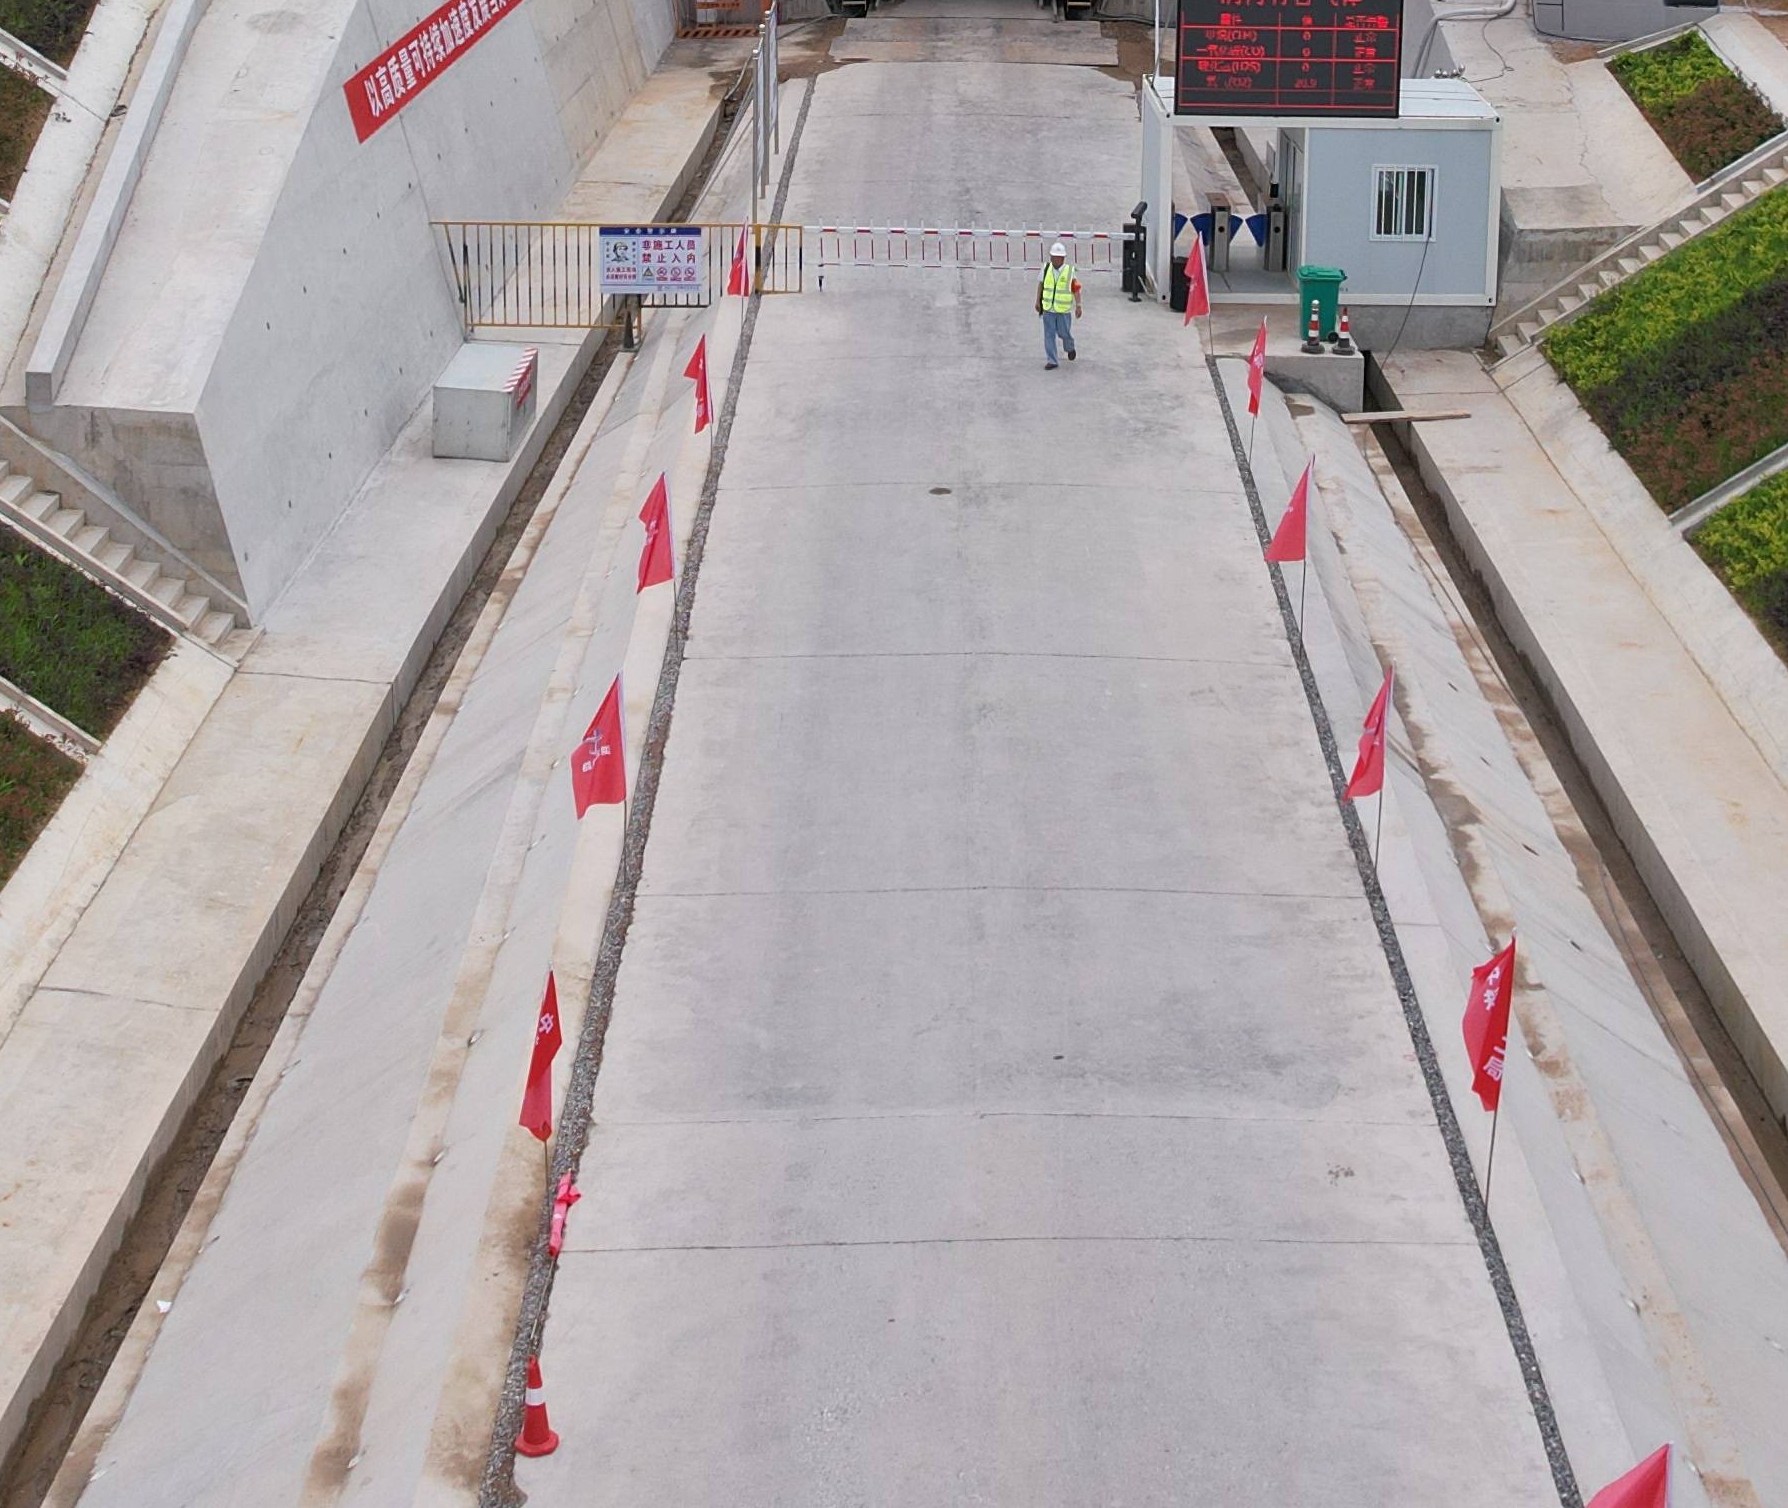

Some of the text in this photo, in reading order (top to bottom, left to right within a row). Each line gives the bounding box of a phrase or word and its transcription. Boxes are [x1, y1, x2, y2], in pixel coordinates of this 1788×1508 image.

[642, 239, 696, 251] 非施工人员
[642, 252, 696, 264] 禁止入内
